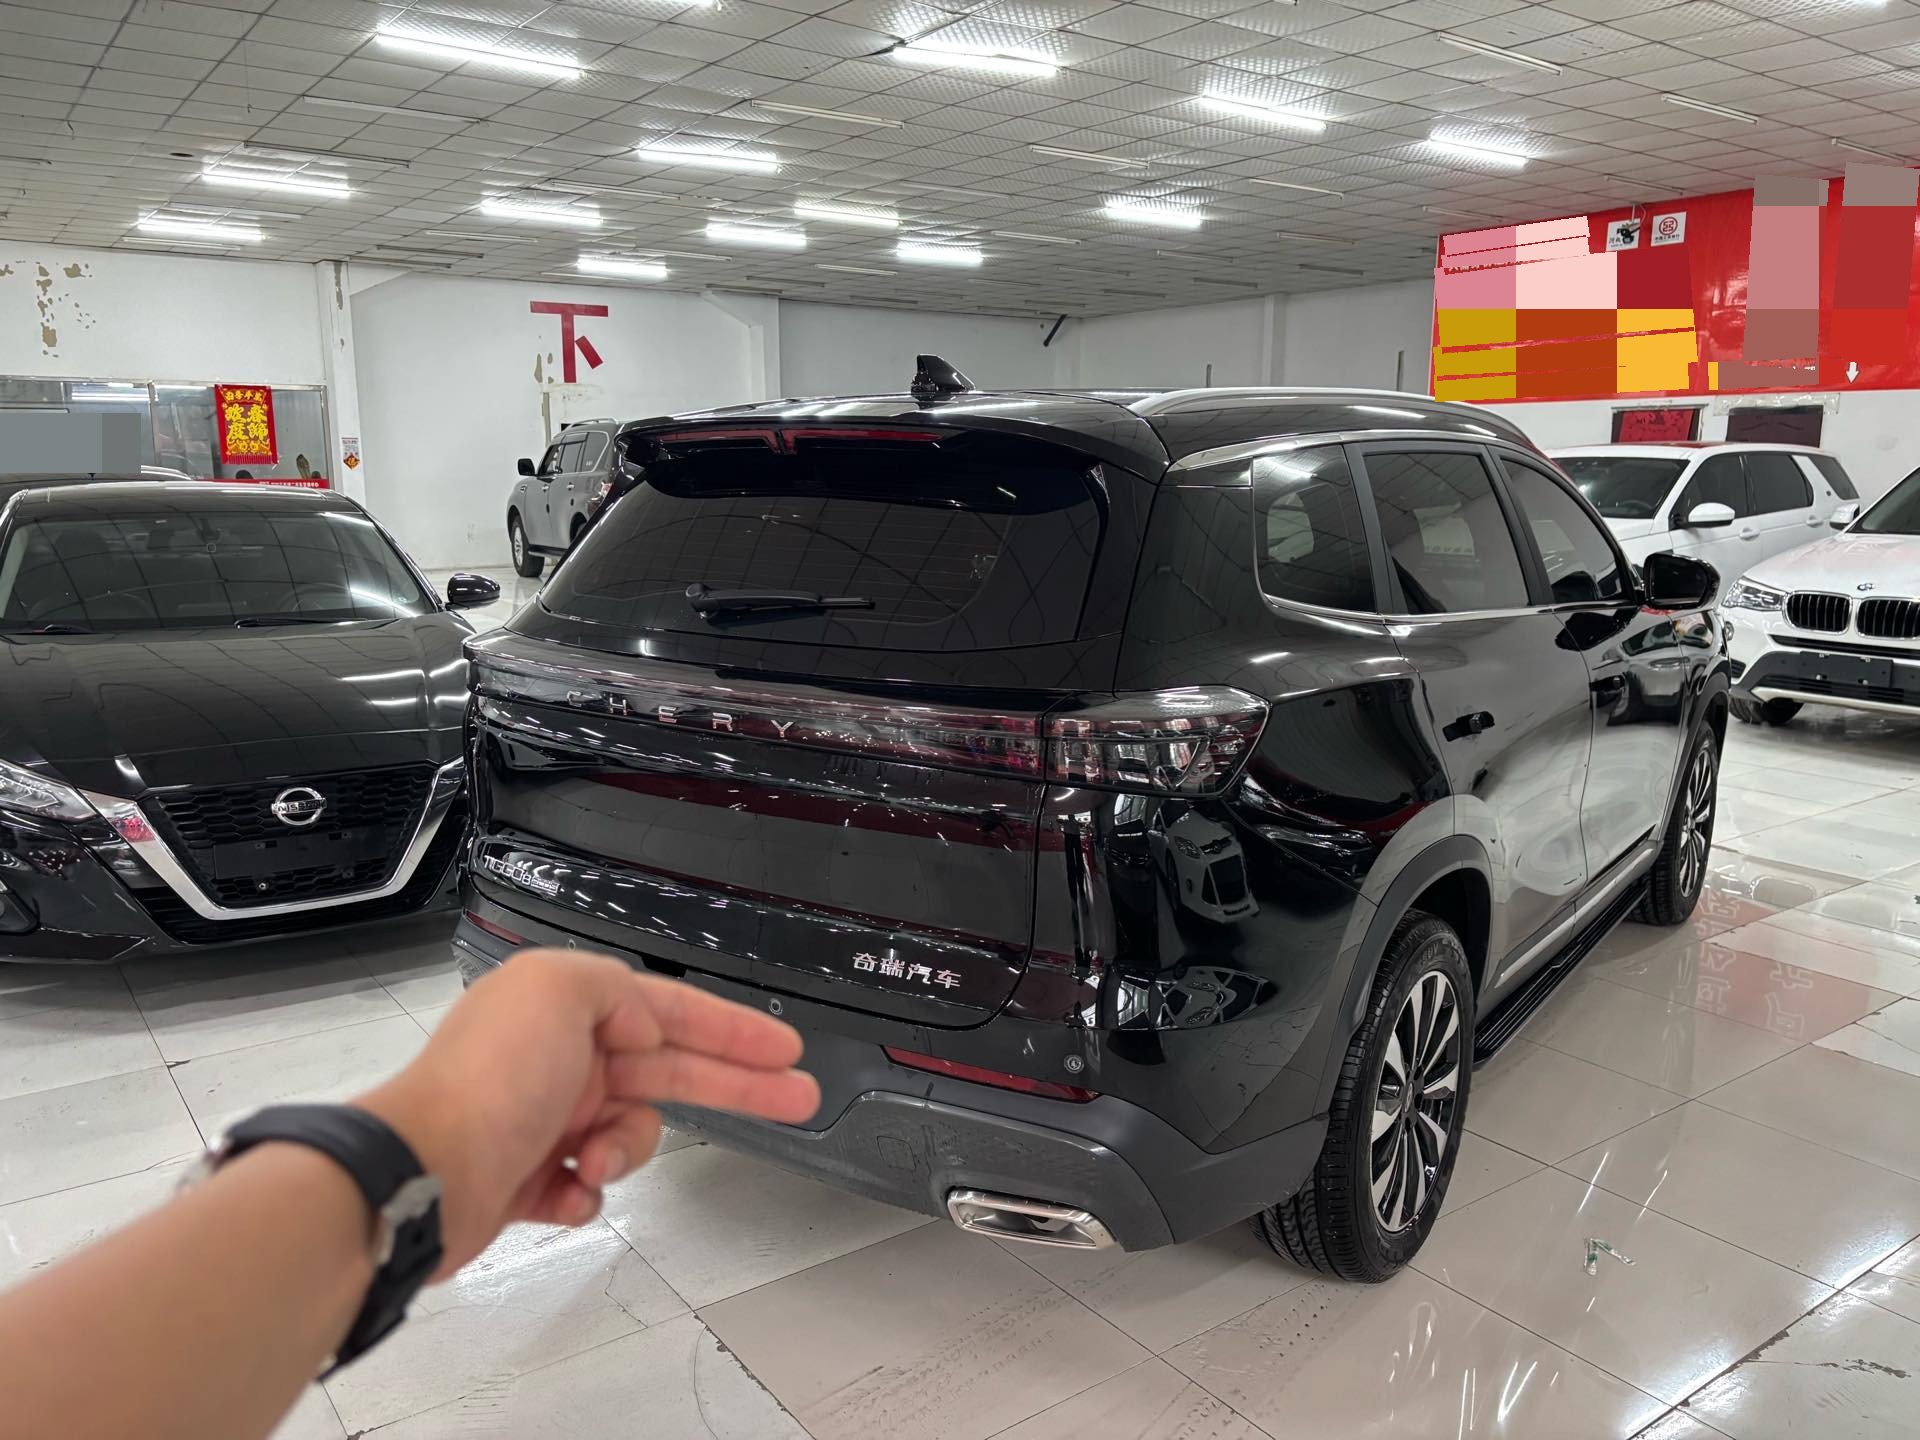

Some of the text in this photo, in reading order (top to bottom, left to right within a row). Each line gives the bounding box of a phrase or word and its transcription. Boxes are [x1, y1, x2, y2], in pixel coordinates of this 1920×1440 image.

[530, 300, 609, 384] 下
[566, 690, 794, 738] CHERY
[852, 952, 962, 989] 奇瑞汽车
